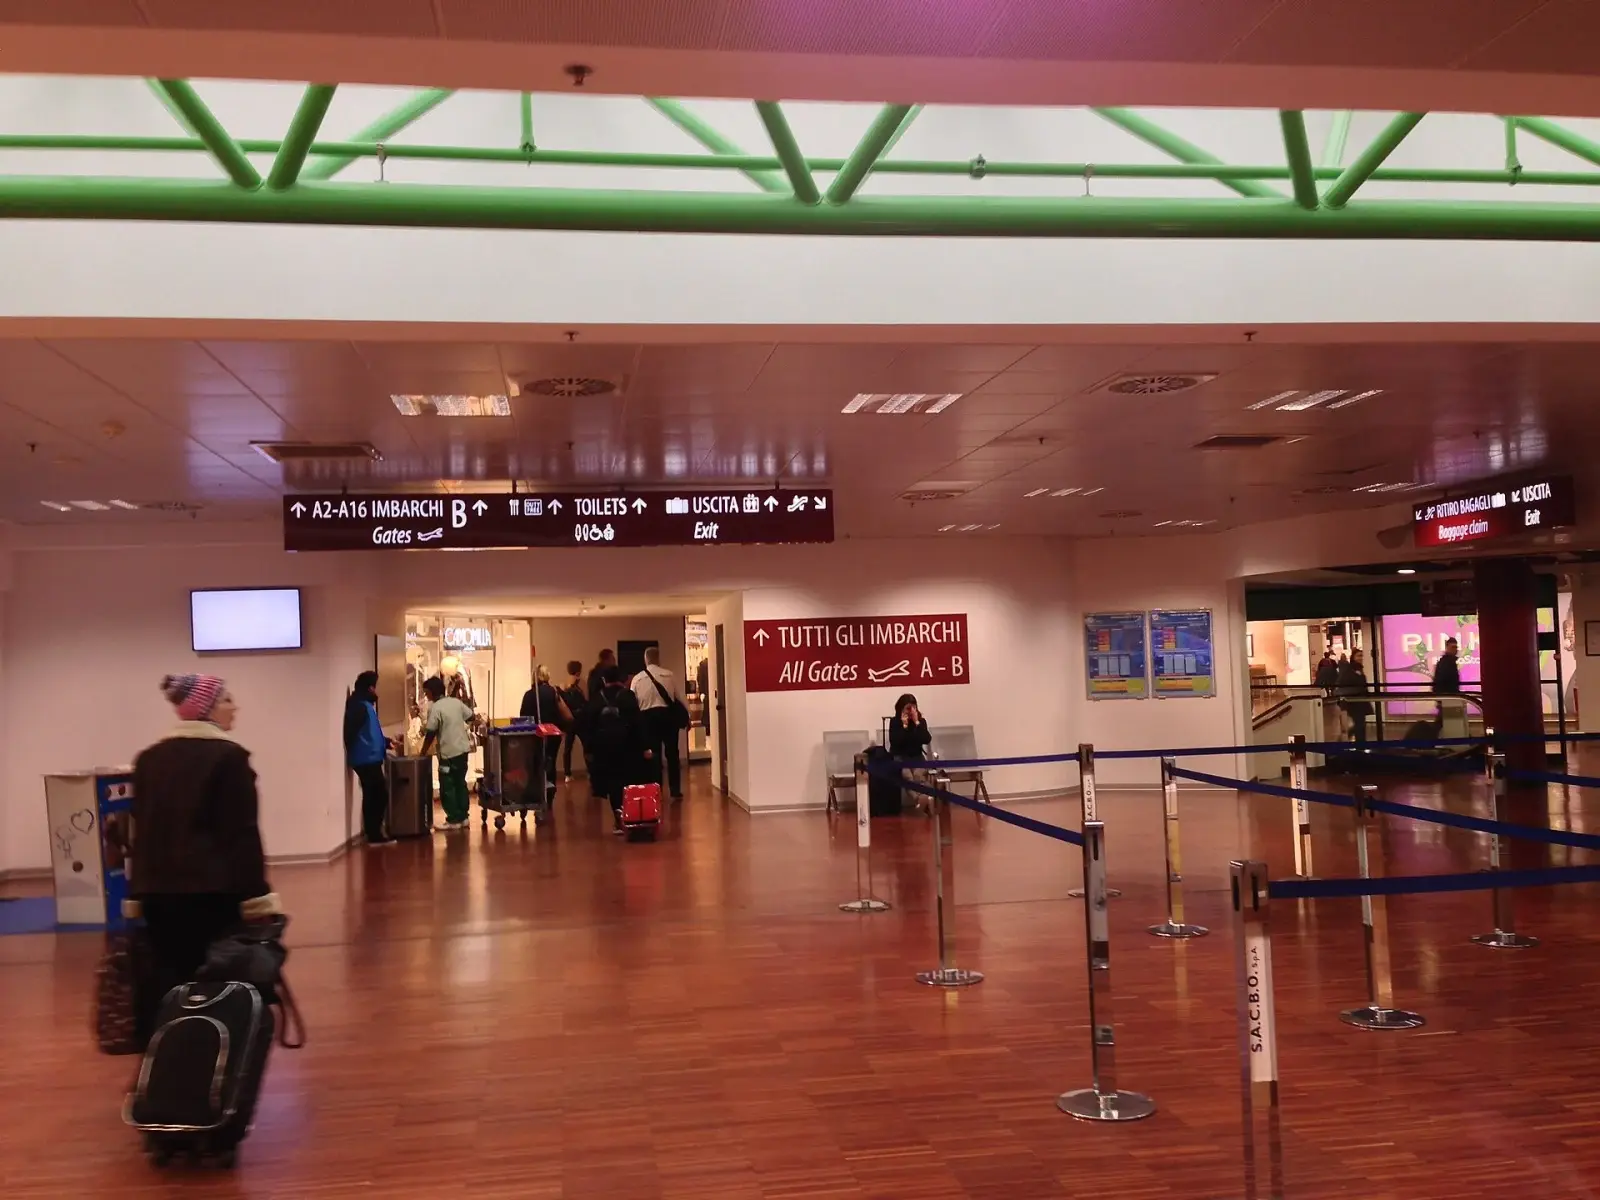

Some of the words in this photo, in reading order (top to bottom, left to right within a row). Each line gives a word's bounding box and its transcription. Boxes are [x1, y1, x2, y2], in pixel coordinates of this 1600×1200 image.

[1522, 482, 1552, 502] USCITA
[312, 500, 367, 519] A2-A16
[372, 499, 444, 518] IMBARCHI
[452, 500, 467, 528] B
[574, 498, 627, 516] TOILETS
[693, 496, 739, 514] USCITA
[1436, 501, 1459, 518] RITIRO
[1460, 494, 1491, 514] BAGAGLI
[1525, 509, 1540, 526] Exit
[372, 526, 412, 544] Gates
[694, 521, 719, 539] Exit
[1438, 524, 1468, 541] Baggage
[1469, 519, 1488, 535] claim
[778, 625, 830, 648] TUTTI
[835, 624, 864, 646] GLI
[870, 621, 961, 645] IMBARCHI
[778, 661, 804, 683] All
[808, 660, 858, 682] Gates
[920, 657, 933, 678] A
[951, 656, 964, 677] B
[1247, 971, 1262, 1053] S.A.C.B.O.
